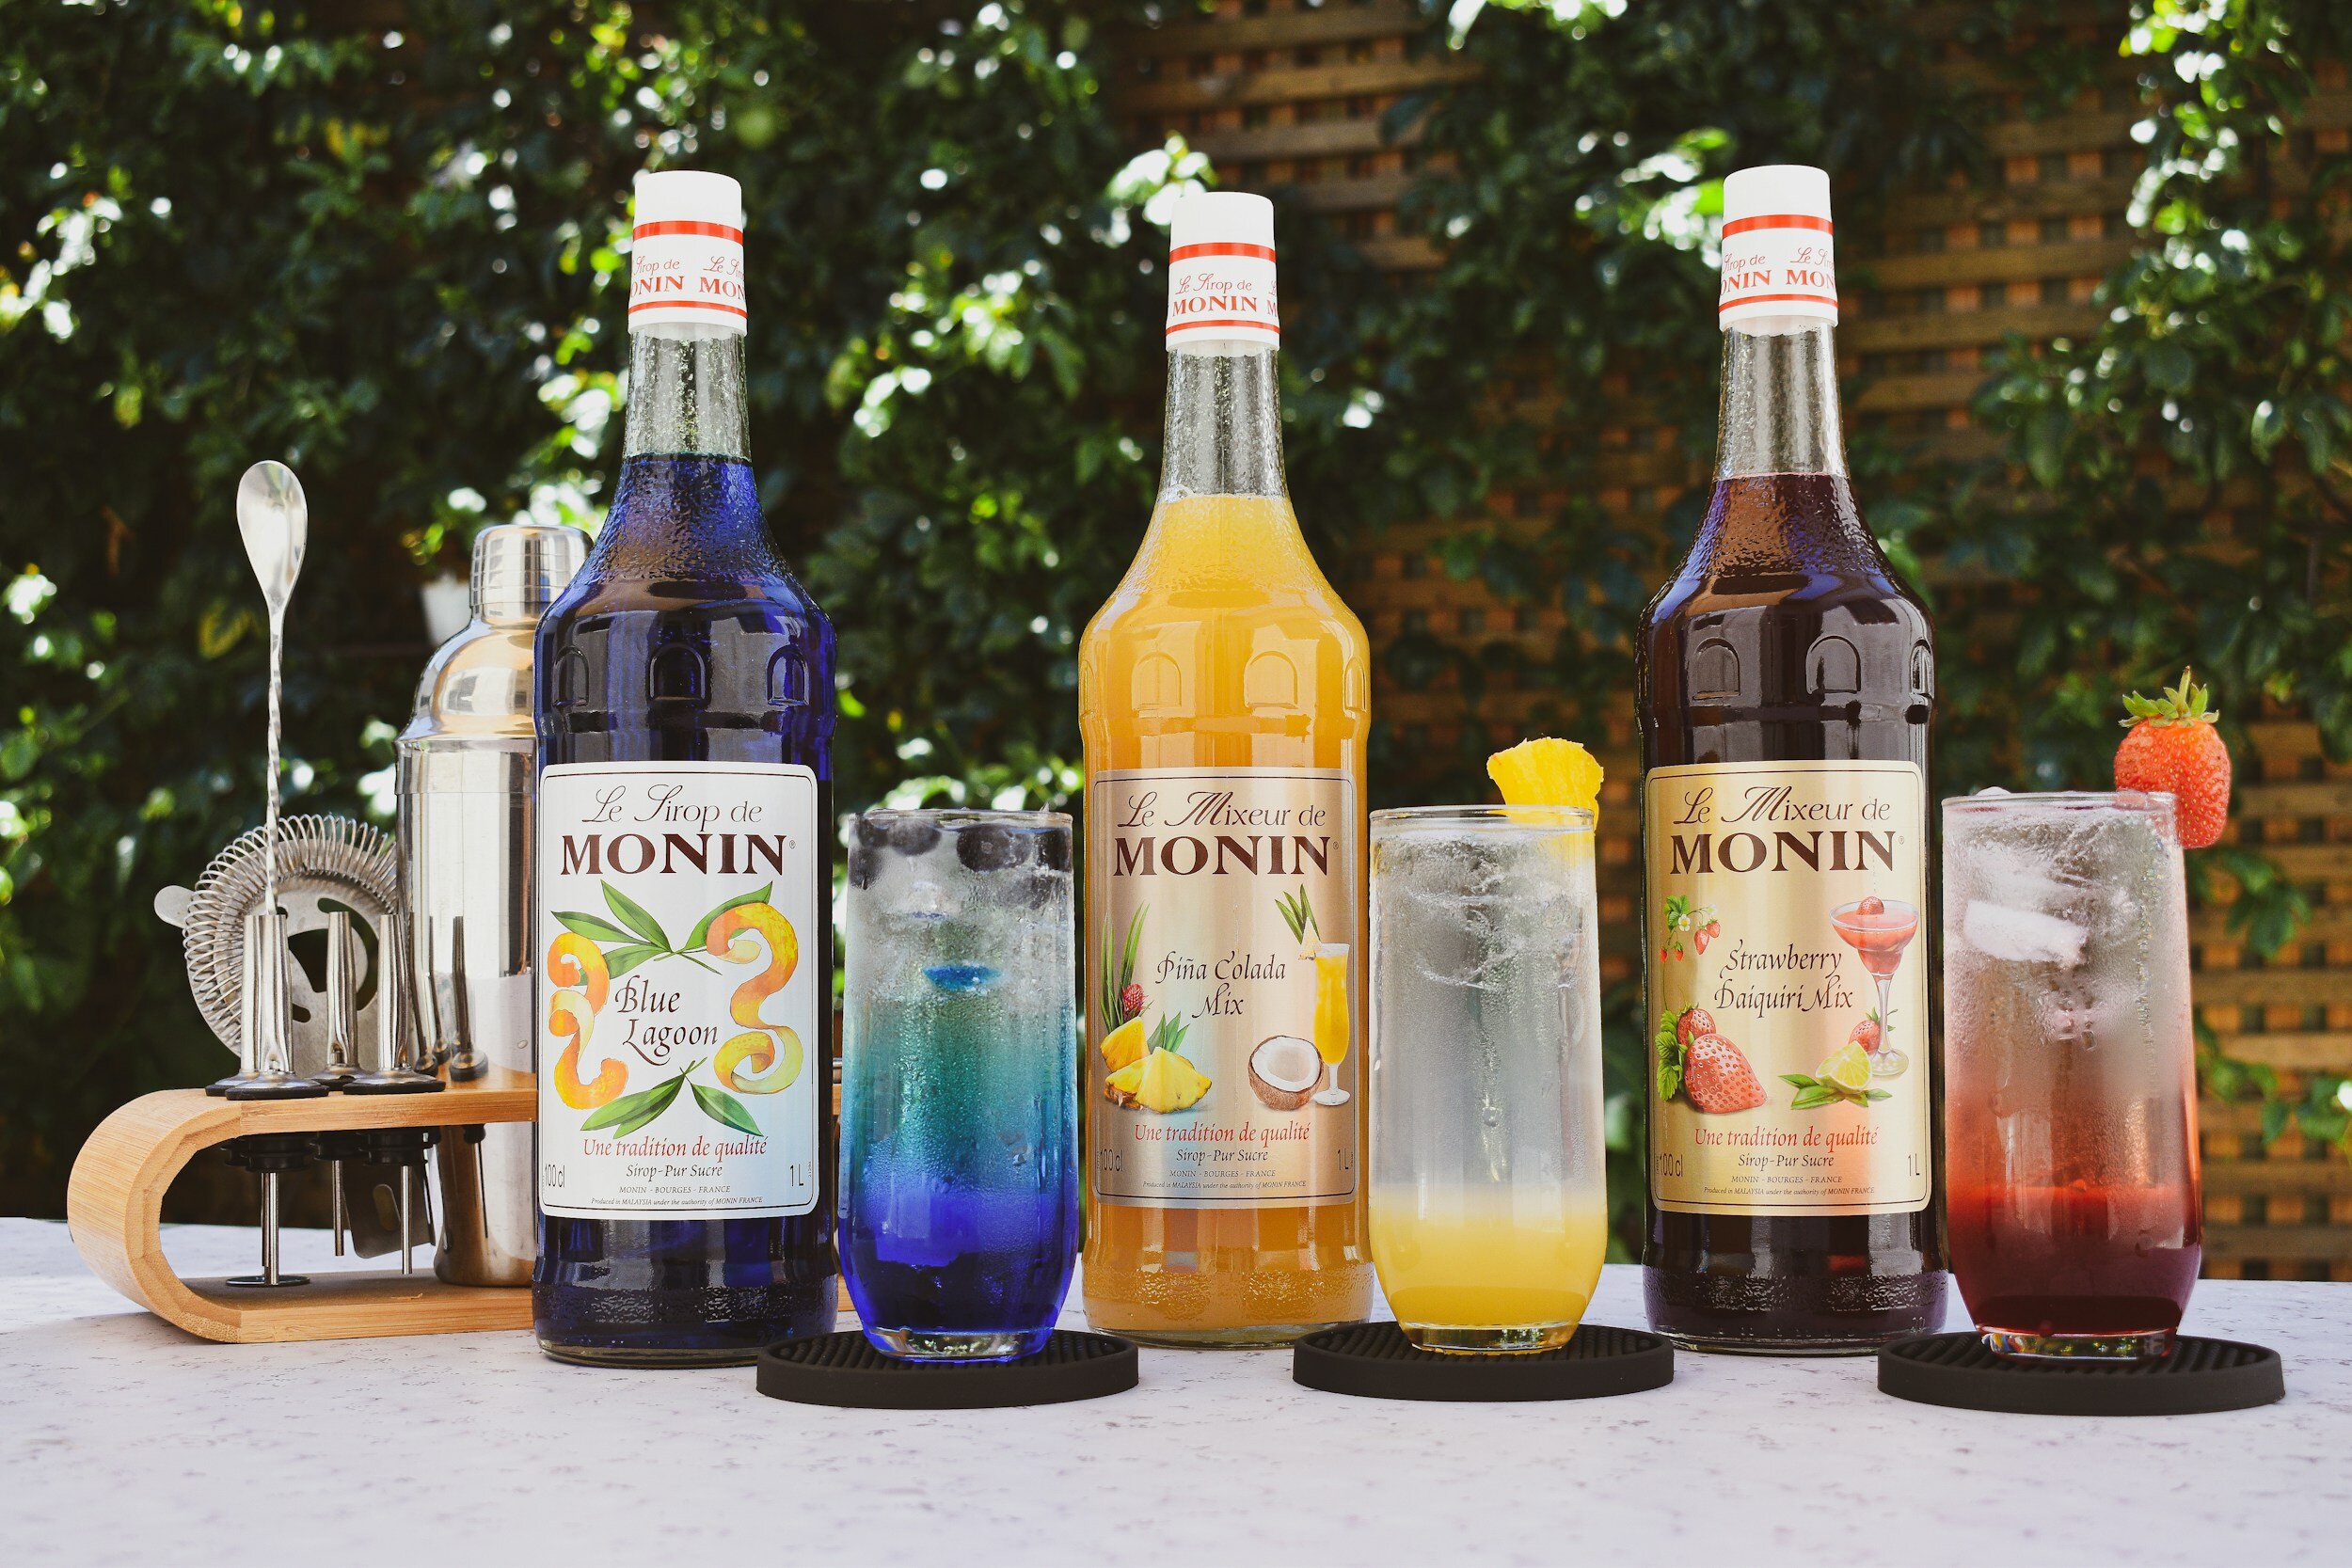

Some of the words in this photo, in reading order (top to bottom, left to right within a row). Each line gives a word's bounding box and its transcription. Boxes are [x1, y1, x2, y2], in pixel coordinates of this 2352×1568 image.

[634, 256, 660, 276] Sirop
[663, 259, 680, 269] de
[703, 256, 724, 273] Le
[1750, 254, 1766, 265] de
[1789, 246, 1812, 264] Le
[1175, 275, 1191, 294] Le
[1193, 273, 1232, 293] Sirop
[1237, 280, 1252, 291] de
[1172, 295, 1257, 317] MONIN
[582, 785, 626, 823] Le
[634, 784, 720, 832] Sirop
[731, 800, 763, 823] de
[1117, 791, 1157, 828] Le
[1164, 790, 1291, 827] Mixeur
[1298, 804, 1326, 827] de
[1673, 786, 1714, 825] Le
[1721, 785, 1853, 823] Mixeur
[1862, 798, 1890, 821] de
[1154, 950, 1207, 984] Piña
[1215, 949, 1286, 981] Colada
[1720, 939, 1842, 979] Strawberry
[614, 974, 680, 1014] Blue
[1192, 982, 1244, 1019] Mix
[1714, 978, 1804, 1019] Daiquiri
[1801, 974, 1853, 1012] Mix
[622, 1019, 719, 1067] Lagoon
[1135, 1124, 1162, 1141] Une
[1166, 1121, 1234, 1142] tradition
[1239, 1121, 1256, 1142] de
[1261, 1120, 1311, 1148] qualité
[1694, 1129, 1723, 1145] Une
[1727, 1126, 1798, 1147] tradition
[1803, 1126, 1821, 1147] de
[1825, 1125, 1879, 1153] qualité
[584, 1139, 612, 1156] Une
[616, 1135, 686, 1156] tradition
[691, 1135, 710, 1156] de
[715, 1134, 769, 1163] qualité
[1237, 1148, 1268, 1161] Sucre
[1802, 1154, 1835, 1166] Sucre
[691, 1164, 723, 1177] Sucre
